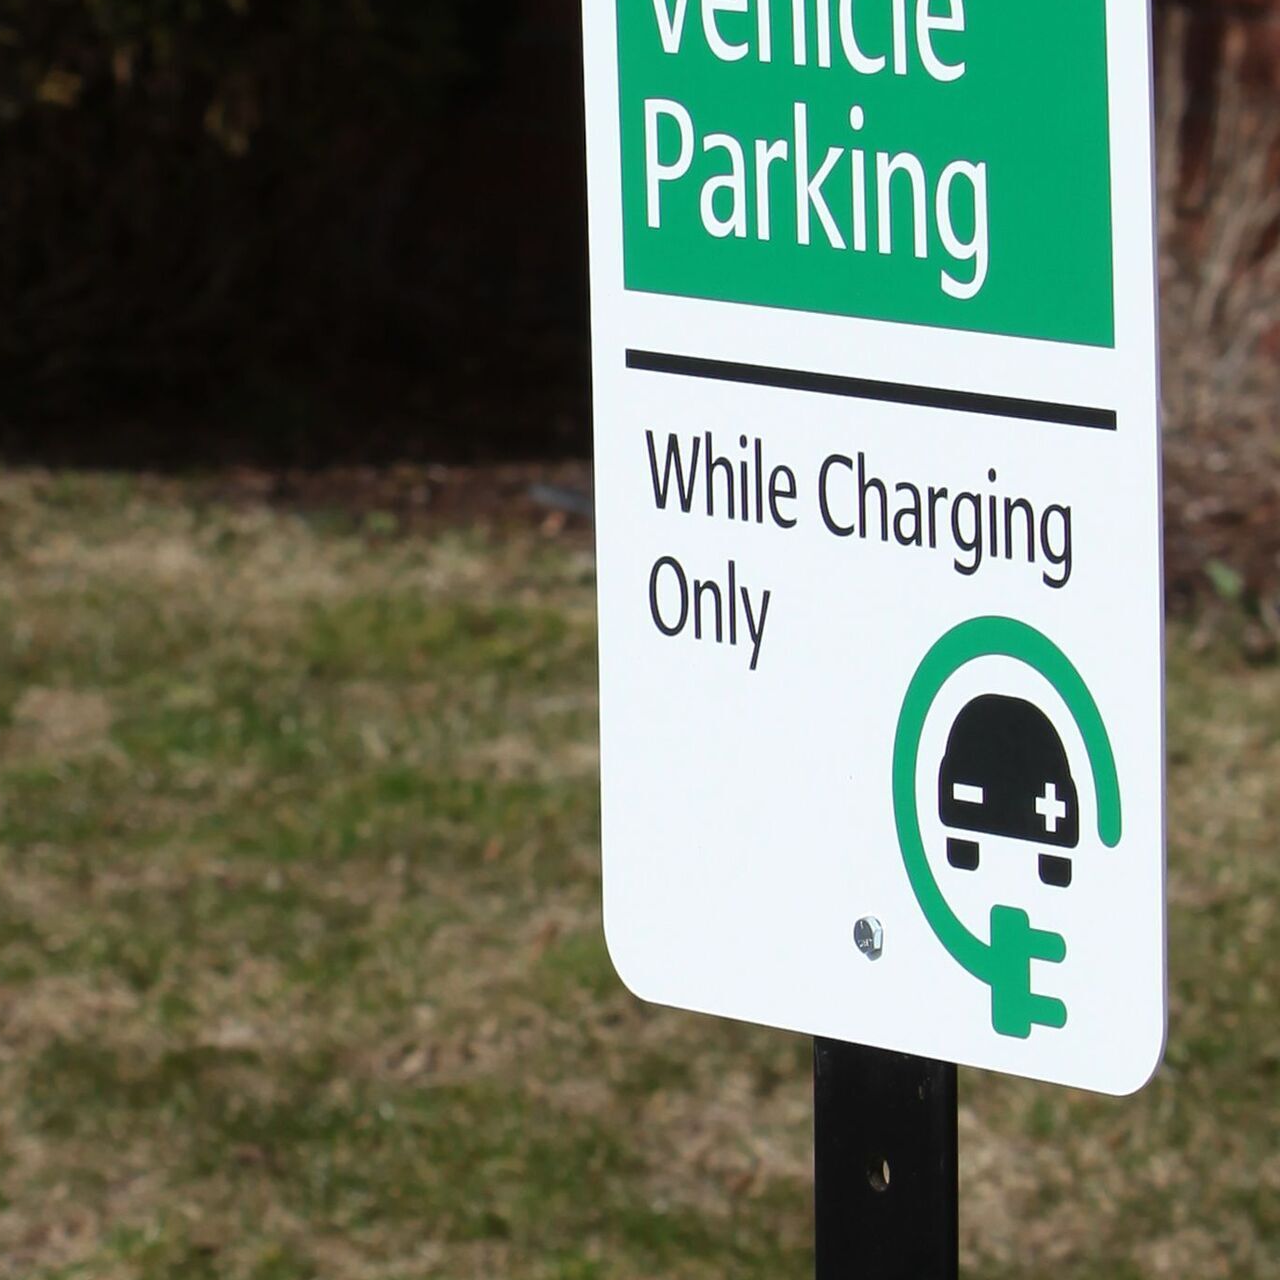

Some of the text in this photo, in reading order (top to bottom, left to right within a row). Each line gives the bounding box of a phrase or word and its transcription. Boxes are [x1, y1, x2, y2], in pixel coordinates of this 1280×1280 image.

[645, 99, 988, 299] Parking
[646, 431, 1071, 588] While Charging
[650, 556, 770, 670] Only
